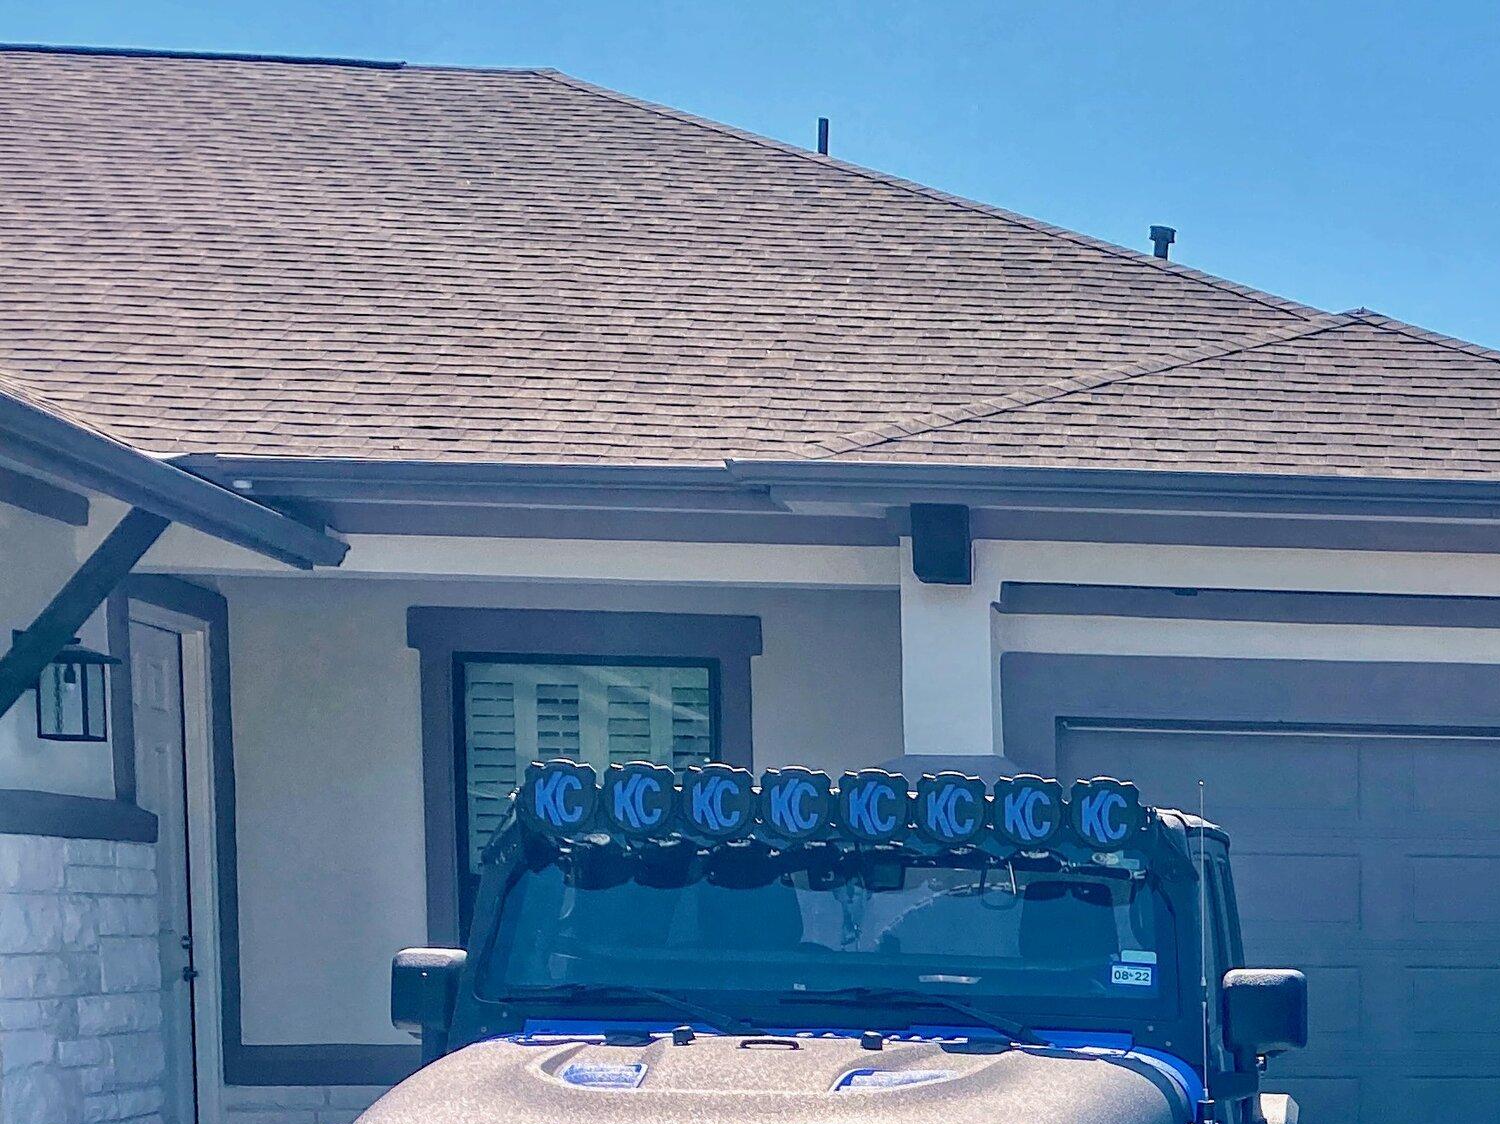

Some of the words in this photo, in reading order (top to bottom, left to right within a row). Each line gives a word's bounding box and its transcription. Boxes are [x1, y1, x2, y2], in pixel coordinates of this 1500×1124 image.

[534, 771, 582, 826] KC
[613, 773, 661, 828] KC
[692, 776, 740, 830] KC
[771, 778, 818, 832] KC
[849, 781, 896, 836] KC
[927, 784, 974, 838] KC
[1004, 787, 1051, 841] KC
[1081, 790, 1128, 843] KC
